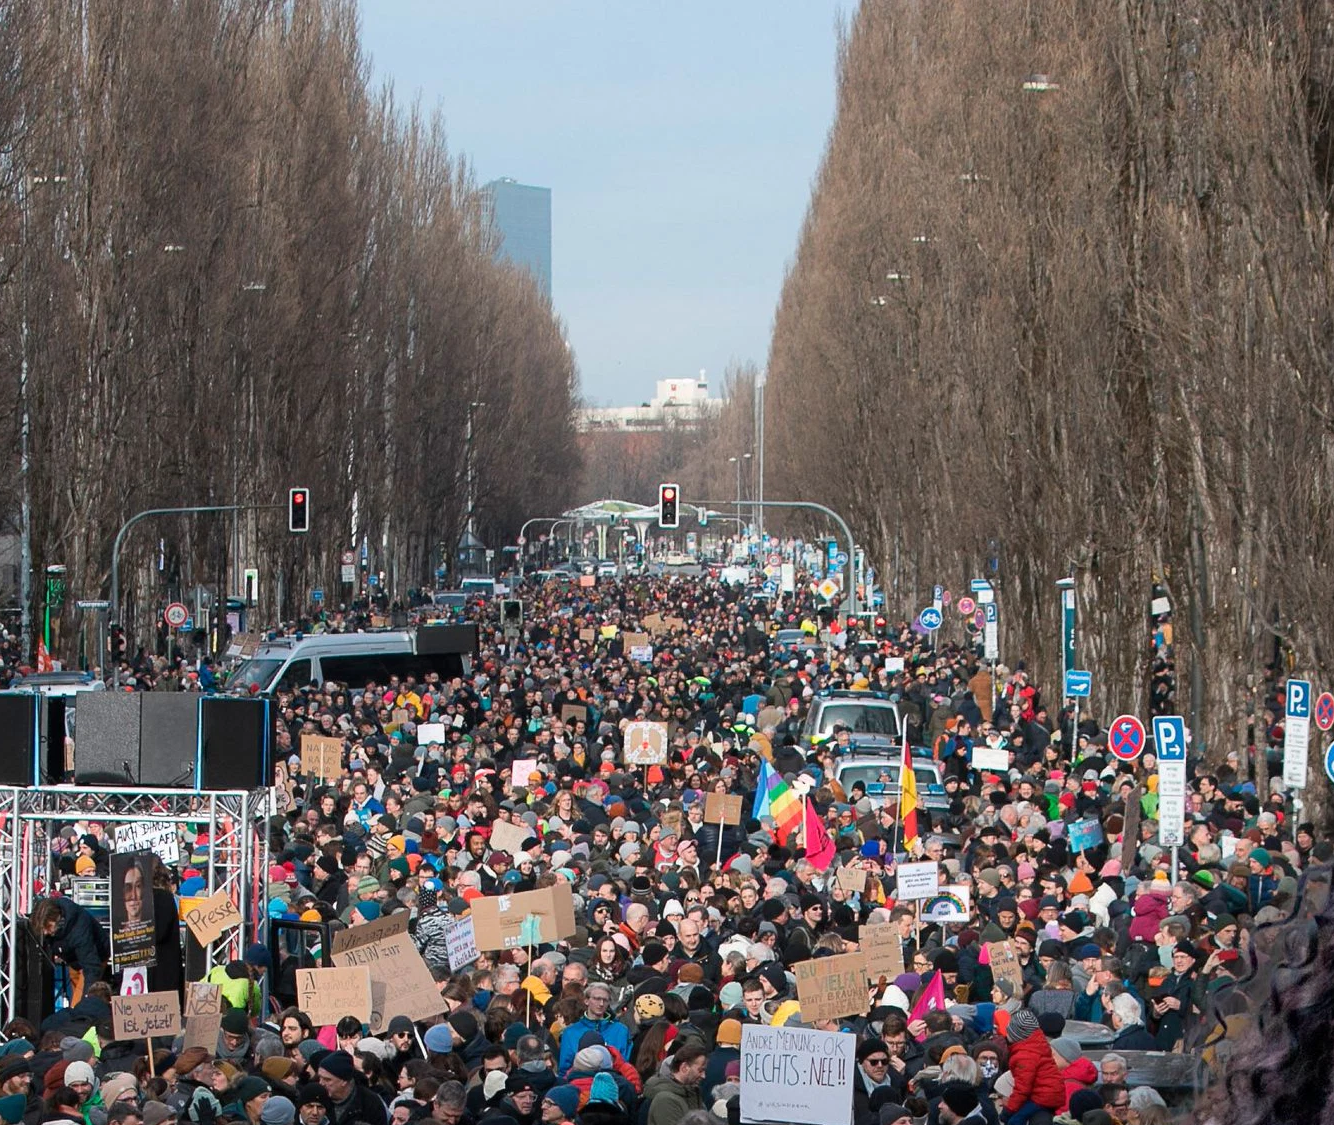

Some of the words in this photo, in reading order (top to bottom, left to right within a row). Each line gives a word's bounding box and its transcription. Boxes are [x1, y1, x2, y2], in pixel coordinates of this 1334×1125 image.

[1289, 685, 1304, 709] P
[1158, 722, 1178, 746] P
[186, 899, 238, 932] Presse
[114, 1002, 132, 1016] Nie
[138, 1000, 169, 1014] wieder
[123, 1018, 139, 1033] ist
[823, 1036, 846, 1057] OK
